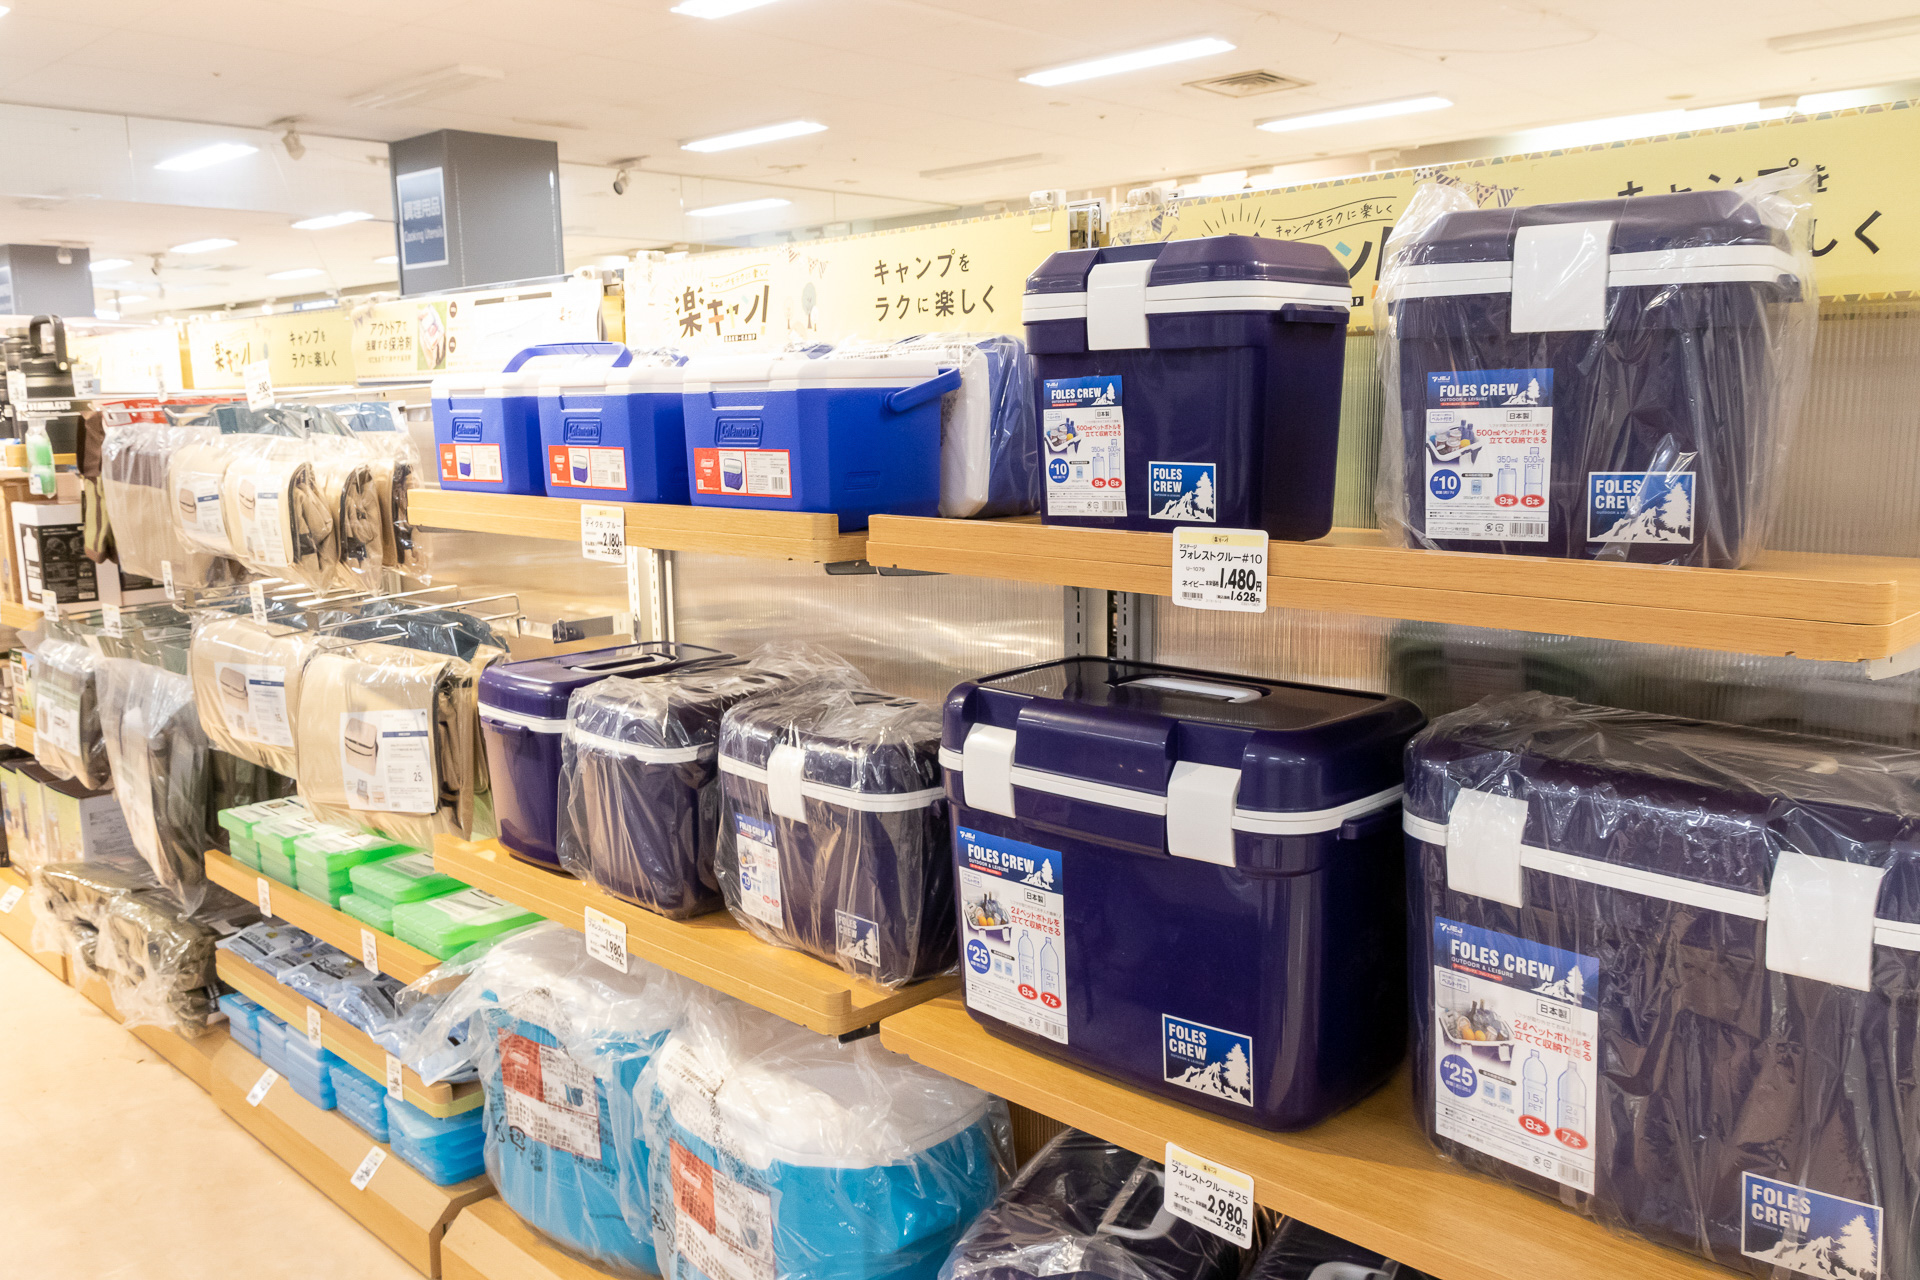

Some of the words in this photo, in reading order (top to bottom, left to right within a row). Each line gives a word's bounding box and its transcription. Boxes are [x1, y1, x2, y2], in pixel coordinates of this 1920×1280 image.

[1275, 203, 1393, 237] キャンプをラクに楽しく
[874, 248, 969, 285] キャンプを
[875, 285, 994, 322] ラクに楽しく
[290, 328, 326, 346] キャンプを
[292, 350, 337, 368] ラクに楽しく
[1051, 388, 1075, 400] FOLES
[1077, 387, 1101, 399] CREW
[1440, 384, 1477, 397] FOLES
[1481, 383, 1518, 396] CREW
[722, 423, 752, 437] Coleman
[1085, 430, 1122, 438] 立てて収納できる
[1050, 463, 1067, 475] #10
[1153, 468, 1182, 481] FOLES
[1153, 480, 1182, 493] CREW
[1433, 476, 1458, 489] #10
[1596, 479, 1641, 494] FOLES
[1499, 497, 1514, 505] 9本
[1525, 497, 1540, 505] 6本
[1180, 549, 1262, 564] フォレストクルー#10
[1182, 580, 1204, 588] ネイビー
[967, 843, 999, 865] FOLES
[1001, 852, 1035, 874] CREW
[969, 858, 987, 867] OUTDOOR
[1026, 891, 1044, 904] 日本製
[1011, 915, 1061, 936] 立てて収納できる
[1448, 925, 1463, 935] JEJ
[969, 944, 988, 965] #25
[1451, 939, 1499, 967] FOLES
[1504, 953, 1555, 981] CREW
[1451, 957, 1480, 968] OUTDOOR
[1488, 967, 1514, 979] LEISURE
[1022, 972, 1032, 980] PET
[1022, 987, 1034, 998] 8本
[1045, 995, 1057, 1006] 7本
[1540, 1004, 1568, 1020] 日本製
[1169, 1023, 1207, 1046] FOLES
[1169, 1039, 1206, 1060] CREW
[1514, 1030, 1592, 1062] 立てて収納できる
[1443, 1061, 1473, 1087] #25
[1528, 1103, 1542, 1112] PET
[1525, 1118, 1544, 1134] 8本
[1562, 1131, 1581, 1147] 7本
[1171, 1164, 1248, 1205] フォレストクルー#25
[1174, 1192, 1195, 1204] ネイビー
[1752, 1184, 1811, 1215] FOLES
[1751, 1203, 1810, 1233] CREW
